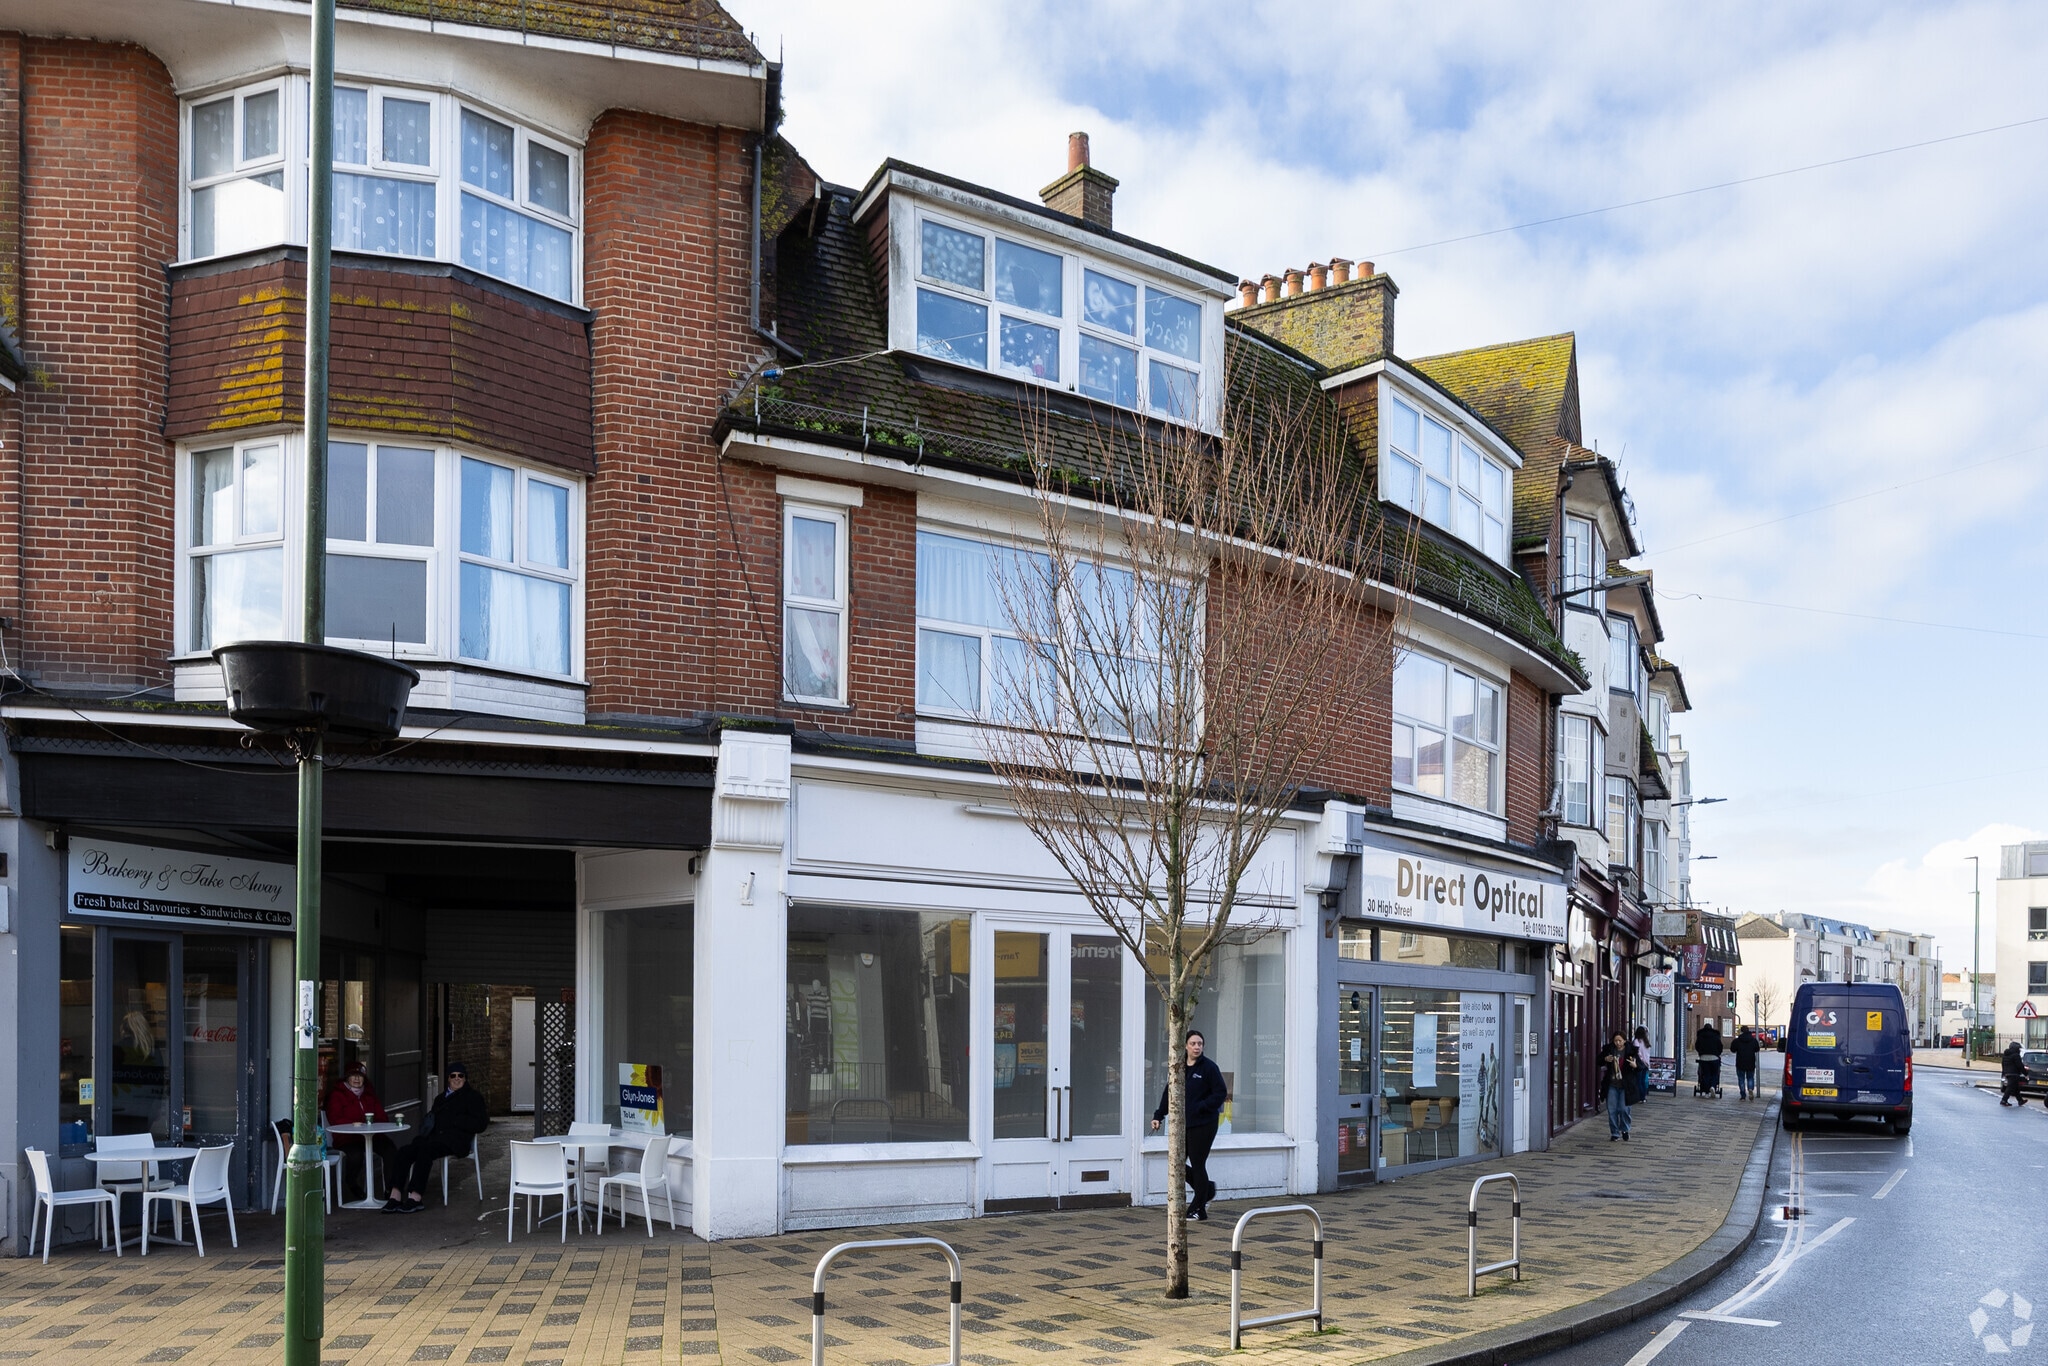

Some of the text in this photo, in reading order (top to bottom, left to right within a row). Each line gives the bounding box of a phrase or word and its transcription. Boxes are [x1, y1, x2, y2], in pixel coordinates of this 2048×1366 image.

[82, 848, 282, 902] Bakery & Take Away
[1397, 857, 1544, 922] Direct Optical
[76, 894, 106, 908] Fresh
[109, 897, 140, 911] baked
[142, 900, 191, 915] Savouries
[200, 905, 253, 920] Sandwiches
[255, 911, 263, 921] &
[265, 912, 291, 923] Cakes
[1367, 898, 1413, 917] 30 High Street
[1532, 922, 1547, 935] 01903
[1463, 1002, 1492, 1011] We also look
[1462, 1014, 1496, 1025] after your ears
[1462, 1029, 1468, 1037] as
[1478, 1029, 1485, 1037] as
[1485, 1029, 1496, 1039] your
[1461, 1042, 1473, 1051] eyes
[622, 1089, 655, 1104] Glyn-Jones
[623, 1110, 636, 1119] To Let
